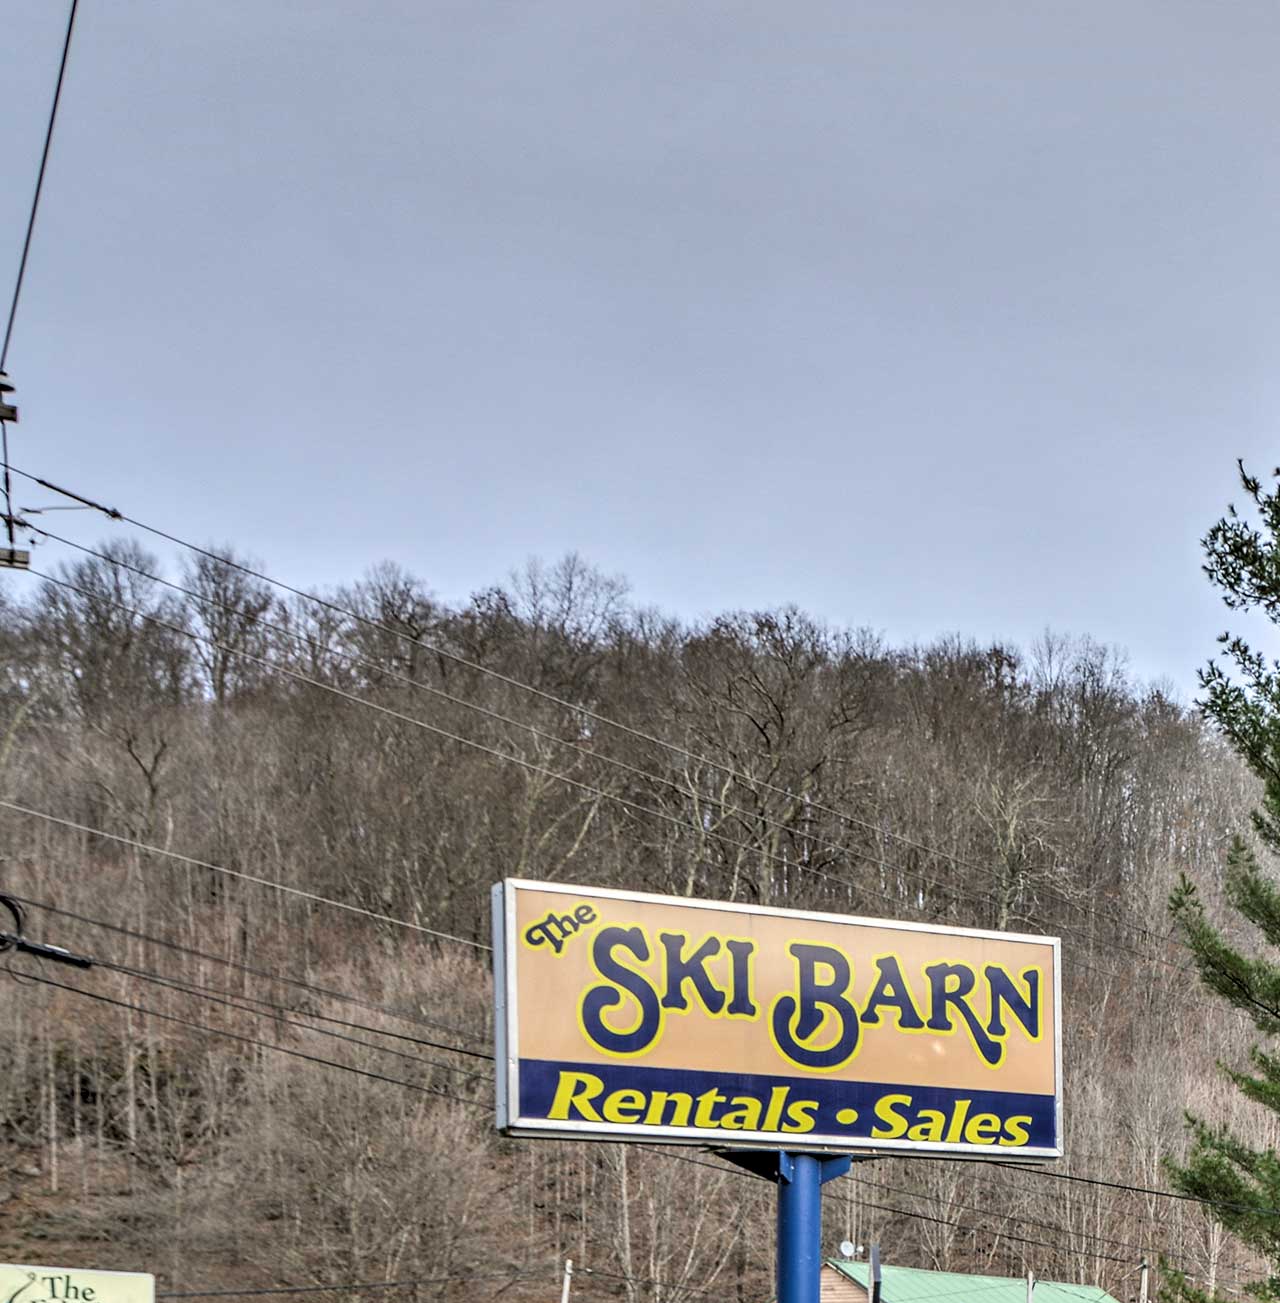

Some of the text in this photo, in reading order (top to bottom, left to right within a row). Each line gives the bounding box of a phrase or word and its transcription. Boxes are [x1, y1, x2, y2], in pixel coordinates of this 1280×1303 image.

[524, 904, 598, 955] The
[579, 923, 1043, 1072] SKI BARN
[547, 1070, 1032, 1148] Rentals Sales
[42, 1275, 95, 1301] The
